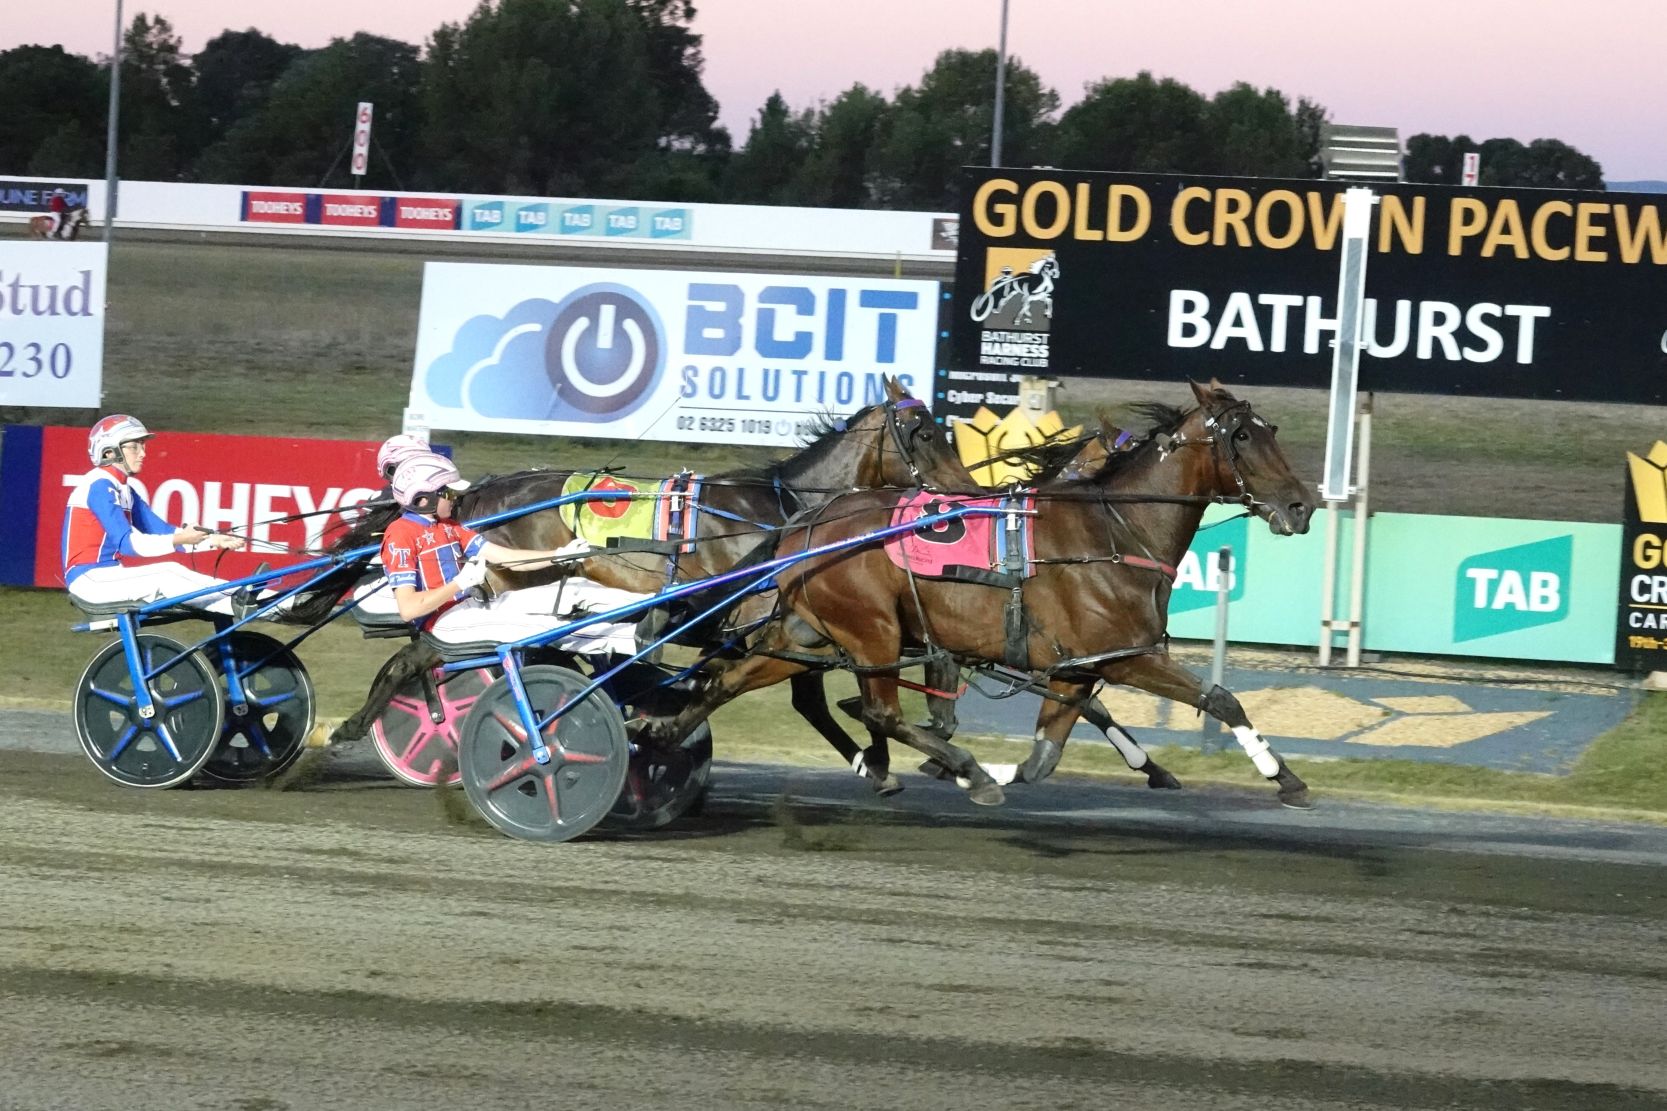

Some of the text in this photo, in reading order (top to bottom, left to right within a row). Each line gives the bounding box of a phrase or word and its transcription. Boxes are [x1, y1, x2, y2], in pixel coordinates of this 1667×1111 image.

[353, 107, 370, 170] 600
[251, 200, 303, 214] TOOHEYS
[325, 203, 377, 217] TOOHEYS
[399, 206, 452, 220] TOOHEYS
[473, 209, 501, 223] TAB
[518, 210, 546, 225] TAB
[563, 213, 591, 227] TAB
[608, 214, 637, 229] TAB
[654, 216, 683, 230] TAB
[972, 178, 1667, 265] GOLD CROWN PACEW
[684, 282, 919, 363] BCIT
[1167, 289, 1551, 364] BATHURST
[982, 331, 1050, 344] BATHURST
[981, 342, 1050, 358] HARNESS
[0, 341, 72, 379] 230
[676, 415, 695, 430] 02
[62, 474, 383, 555] OHEY
[913, 494, 967, 545] 8
[1632, 533, 1667, 570] G
[1171, 550, 1237, 593] AB
[1465, 567, 1560, 613] TAB
